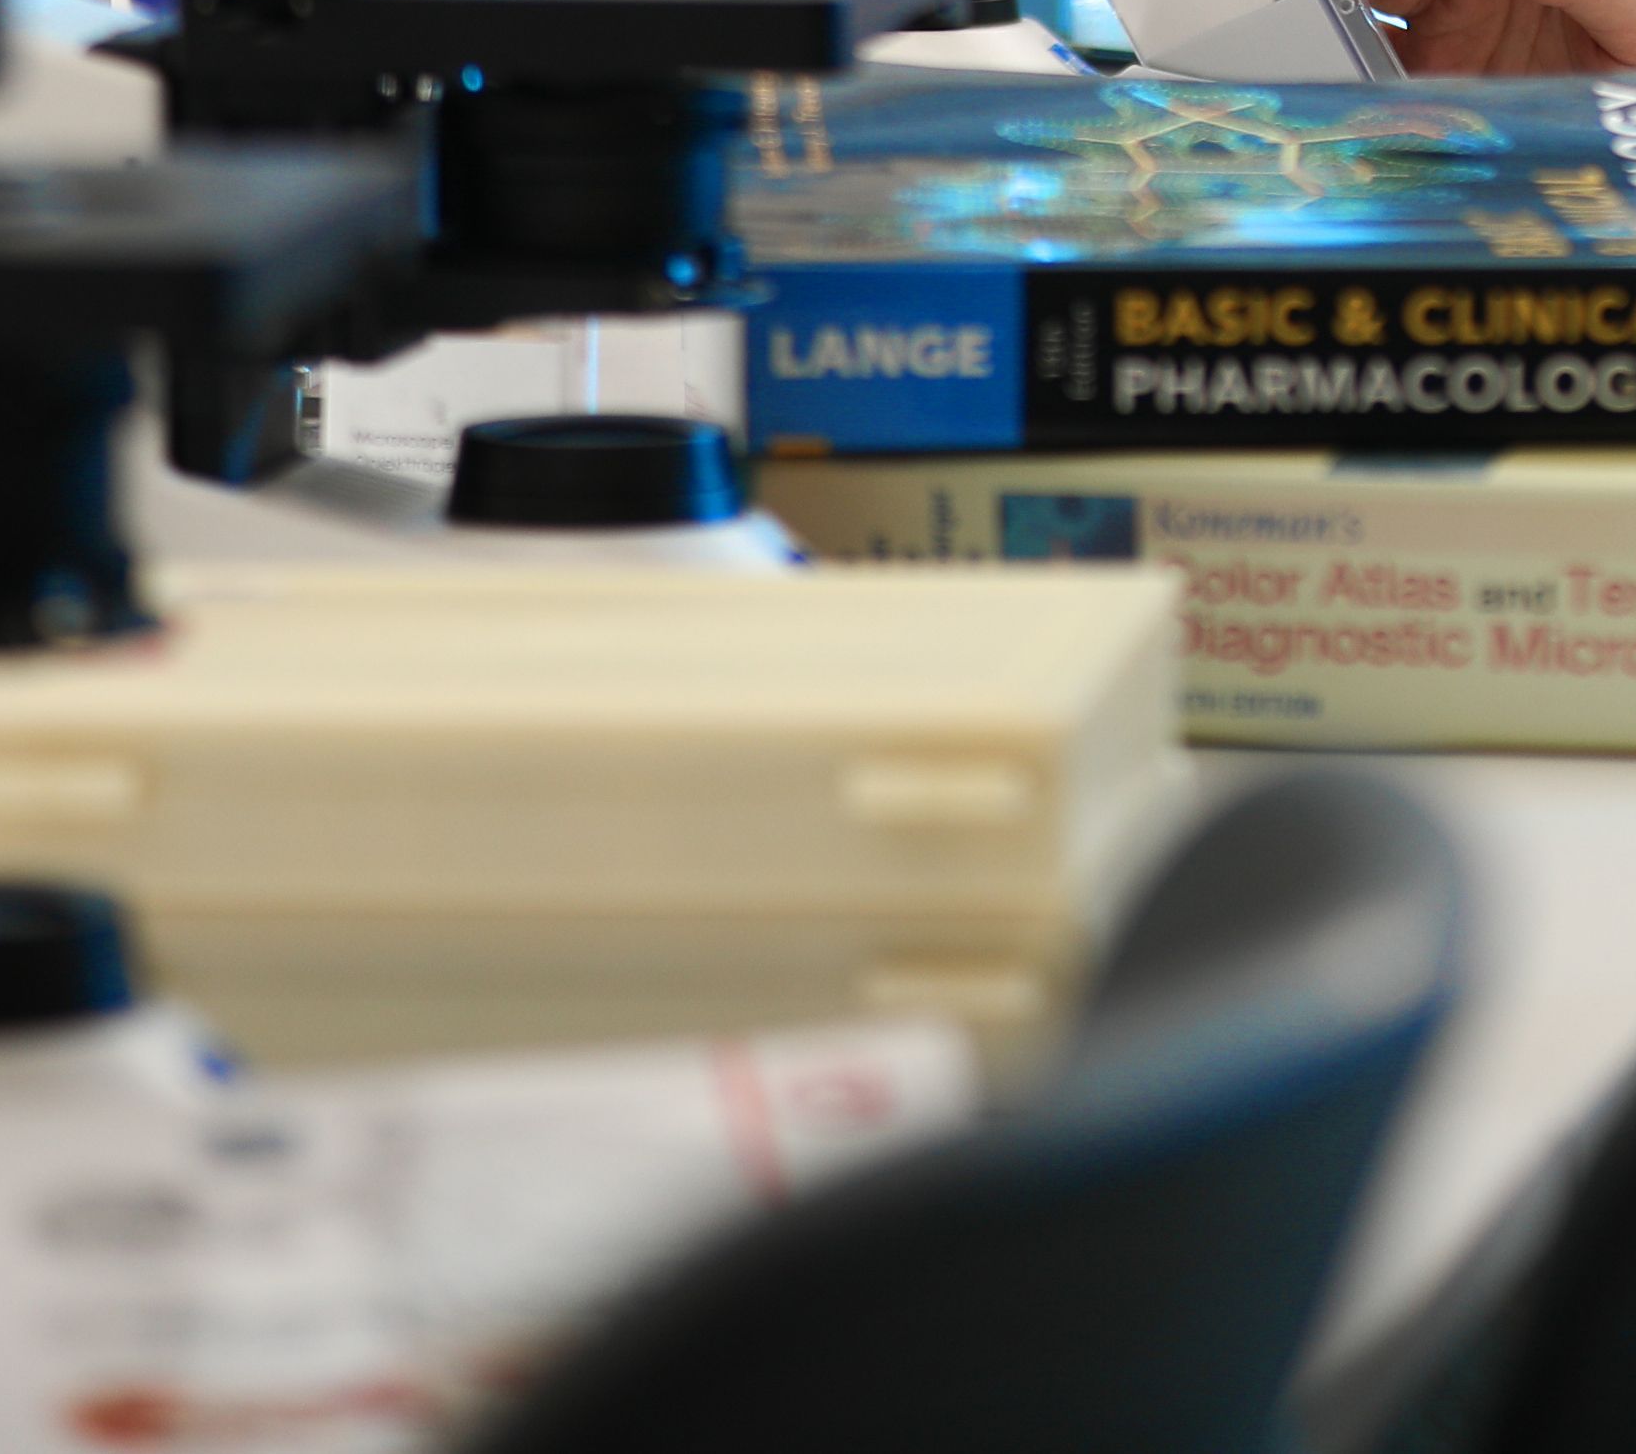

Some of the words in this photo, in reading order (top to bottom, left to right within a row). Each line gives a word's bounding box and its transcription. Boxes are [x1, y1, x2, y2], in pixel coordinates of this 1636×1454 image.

[1112, 288, 1317, 345] BASIC
[1331, 287, 1385, 345] &
[768, 324, 994, 379] LANGE
[1321, 560, 1460, 611] Atlas
[1475, 580, 1558, 615] and
